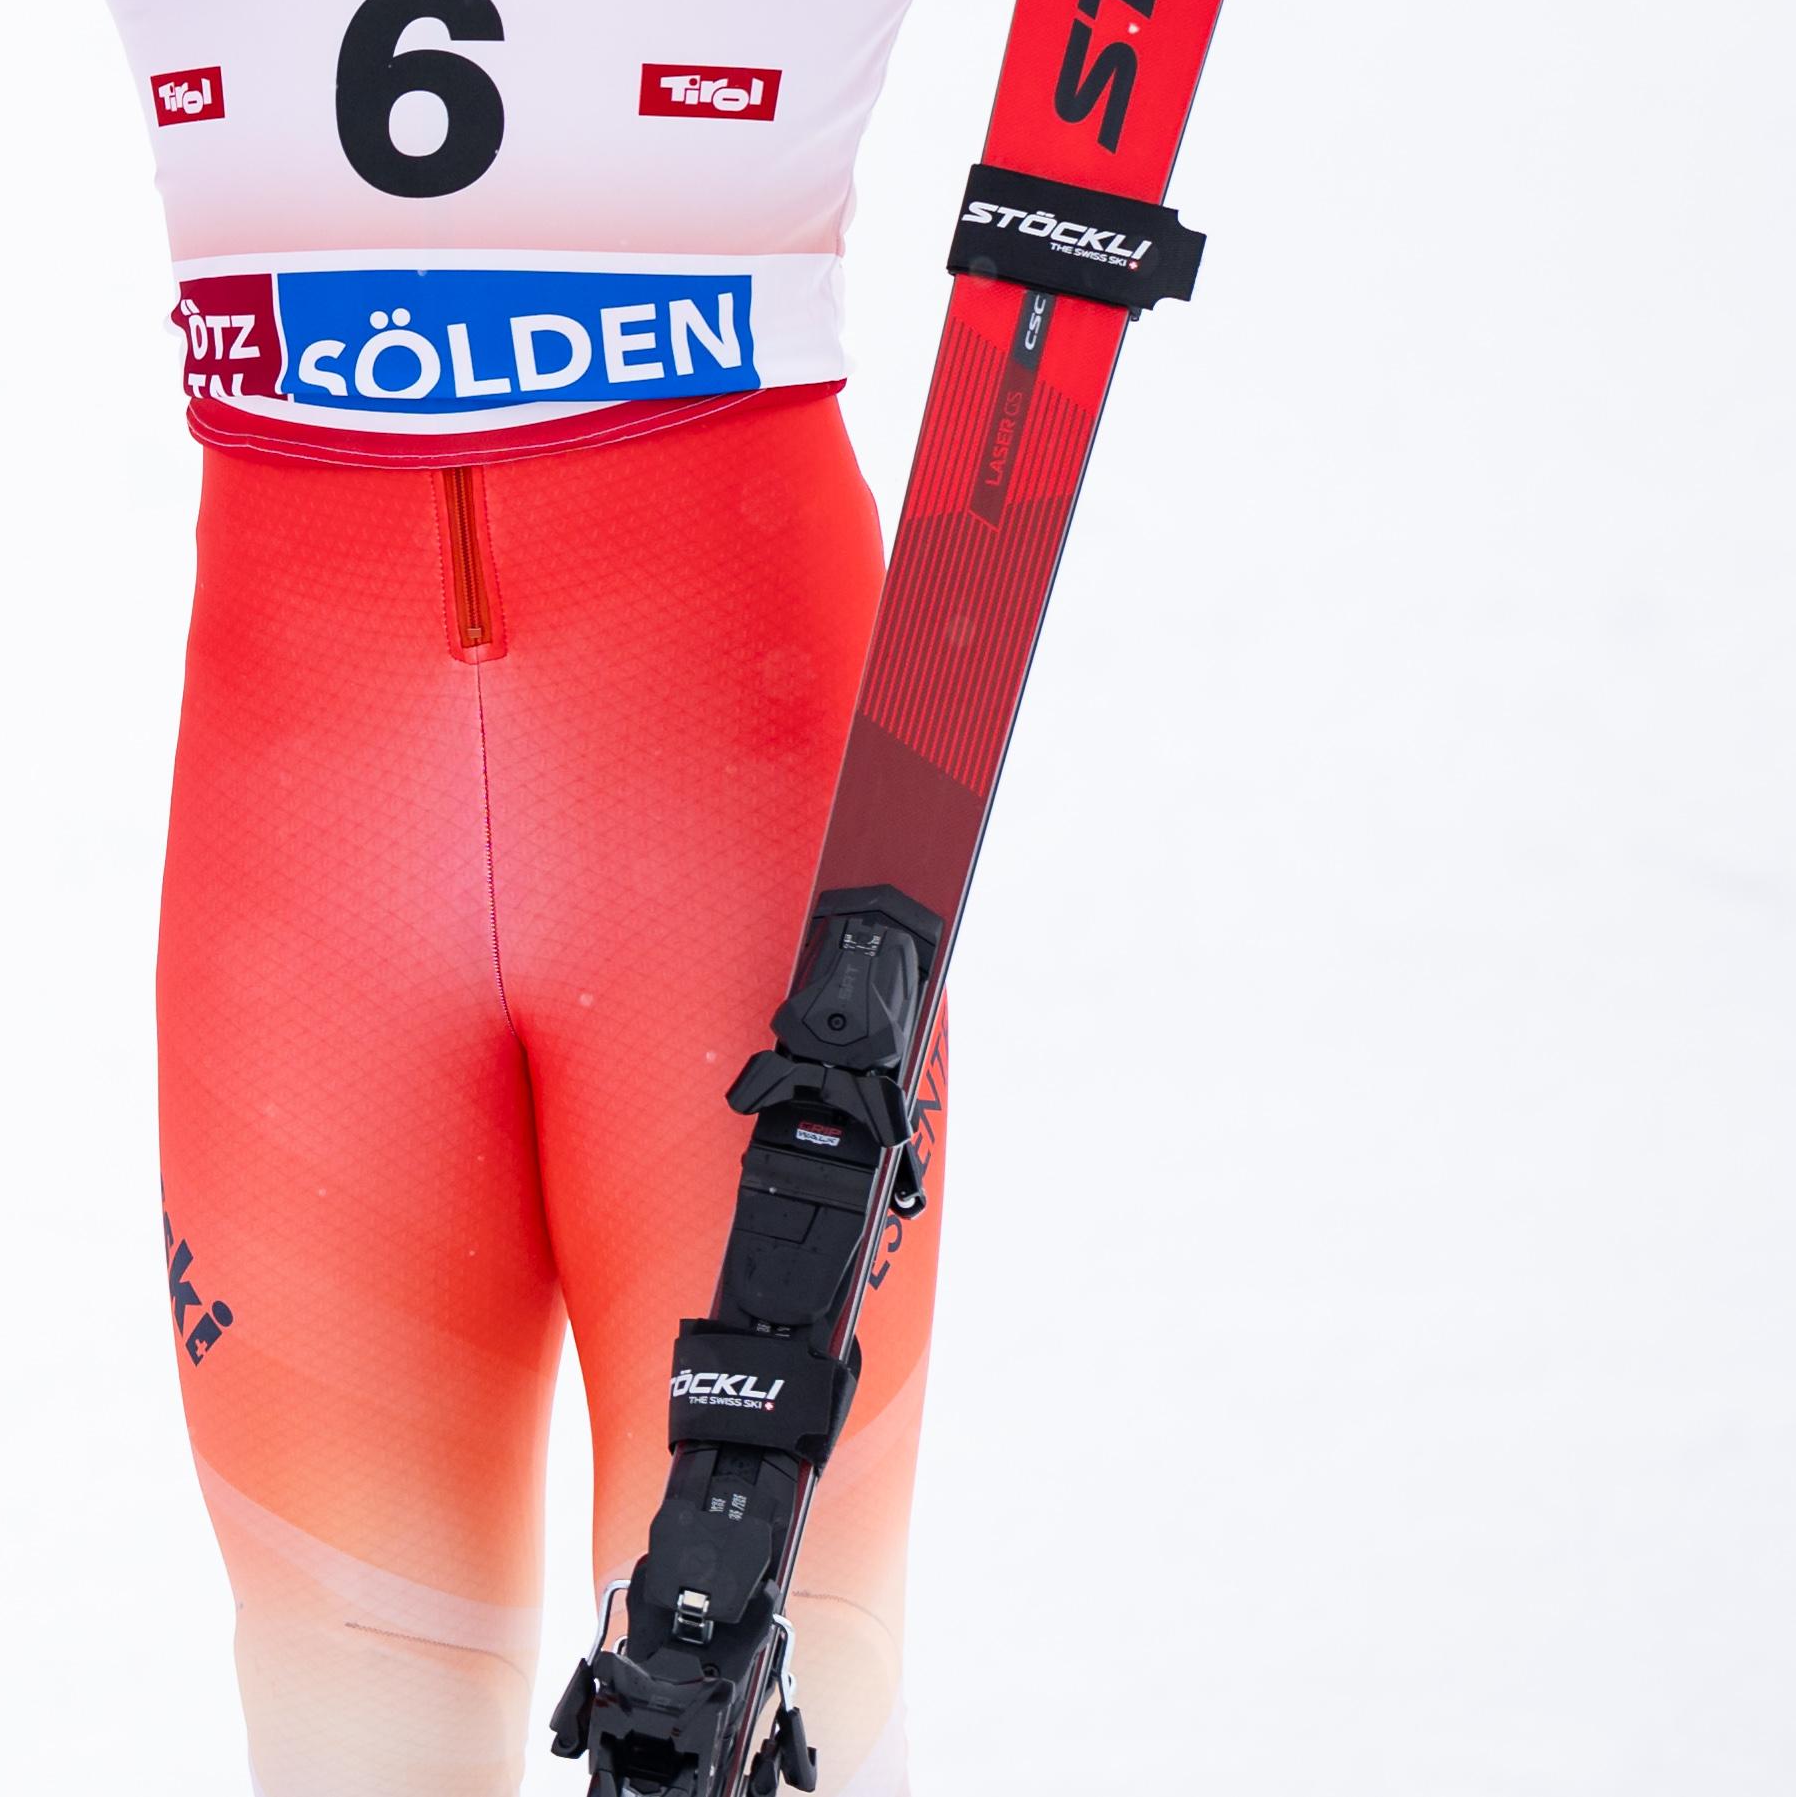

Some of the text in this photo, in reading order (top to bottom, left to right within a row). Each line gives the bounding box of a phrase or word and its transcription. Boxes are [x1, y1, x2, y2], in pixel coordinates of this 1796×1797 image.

[159, 77, 212, 115] Tirol
[659, 74, 764, 113] Tirol
[961, 200, 1153, 260] STÖCKLI
[1050, 242, 1127, 268] THE SWISS SKI
[298, 291, 744, 401] SÖLDEN
[1025, 294, 1047, 351] CSC
[985, 391, 1023, 487] LASER GS
[689, 1395, 762, 1410] THE SWISS SKI
